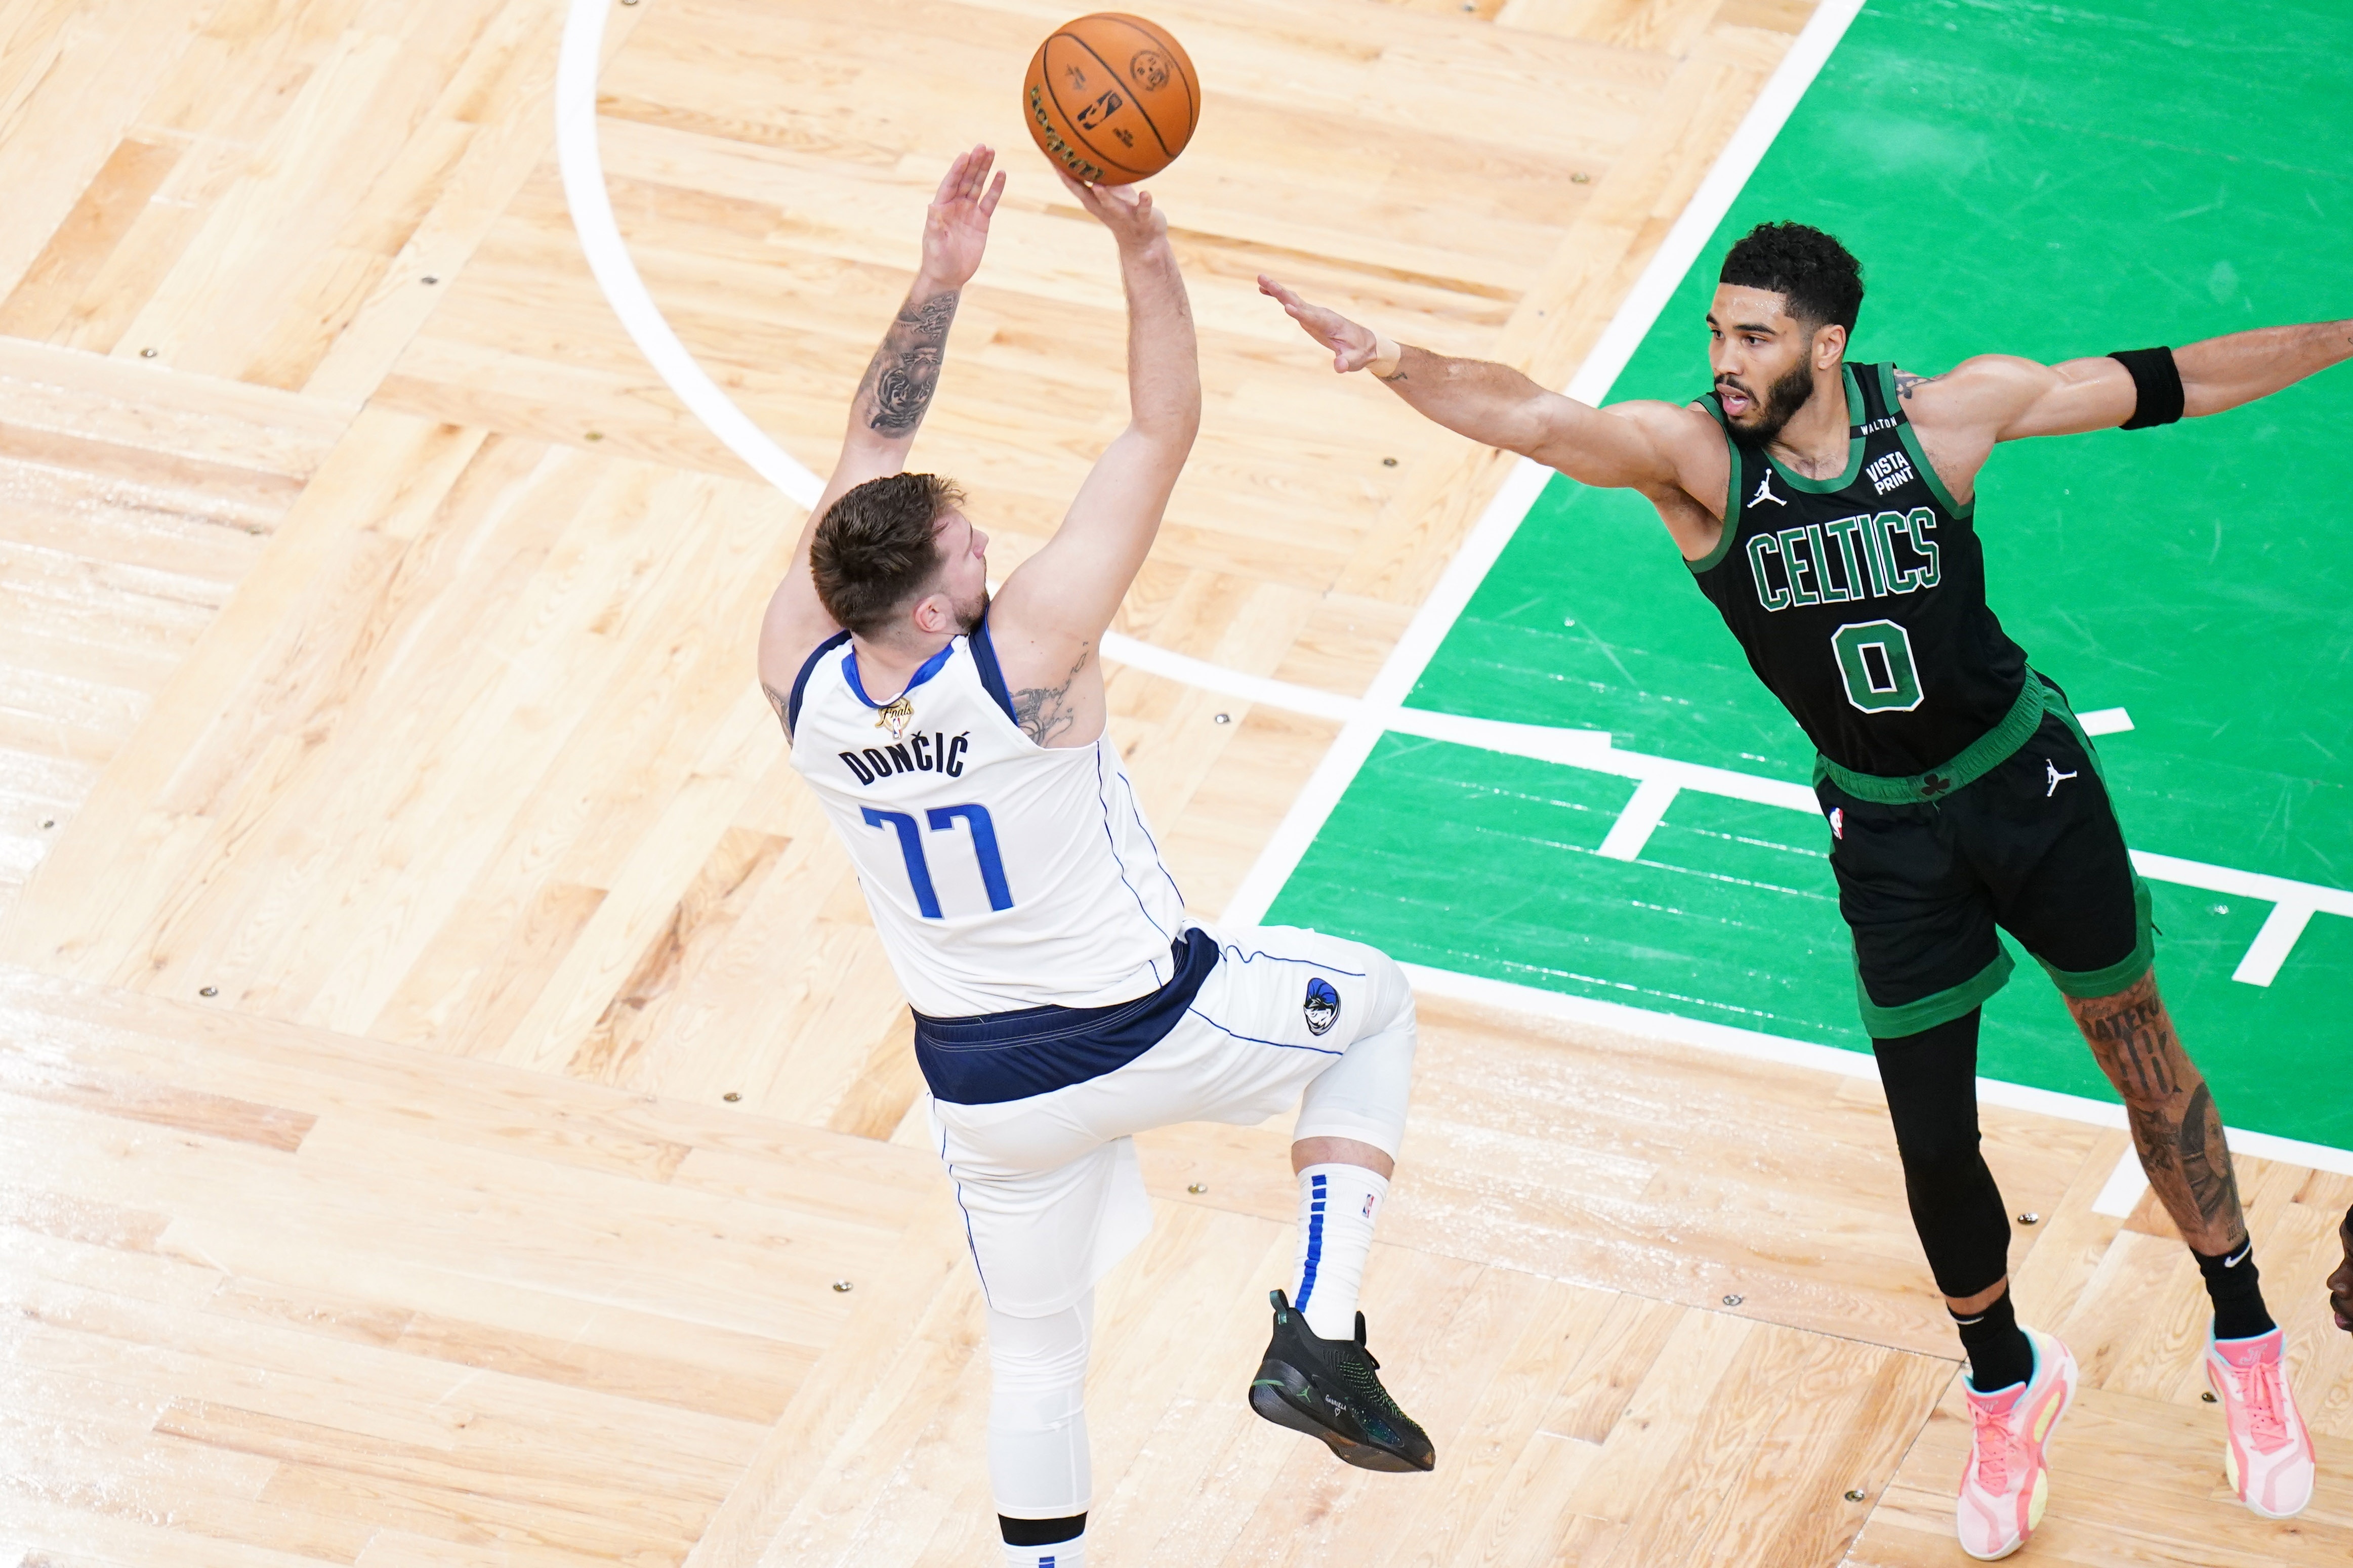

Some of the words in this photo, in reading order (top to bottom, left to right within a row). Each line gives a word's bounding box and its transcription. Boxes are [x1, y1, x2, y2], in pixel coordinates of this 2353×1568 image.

[1860, 416, 1897, 436] WALTON
[1866, 451, 1910, 483] VISTA
[1874, 466, 1914, 495] PRINT
[1746, 506, 1941, 612] CELTICS
[1831, 619, 1924, 714] 0
[875, 702, 912, 727] Finals
[838, 730, 971, 786] DONČIĆ
[858, 801, 1016, 920] 77
